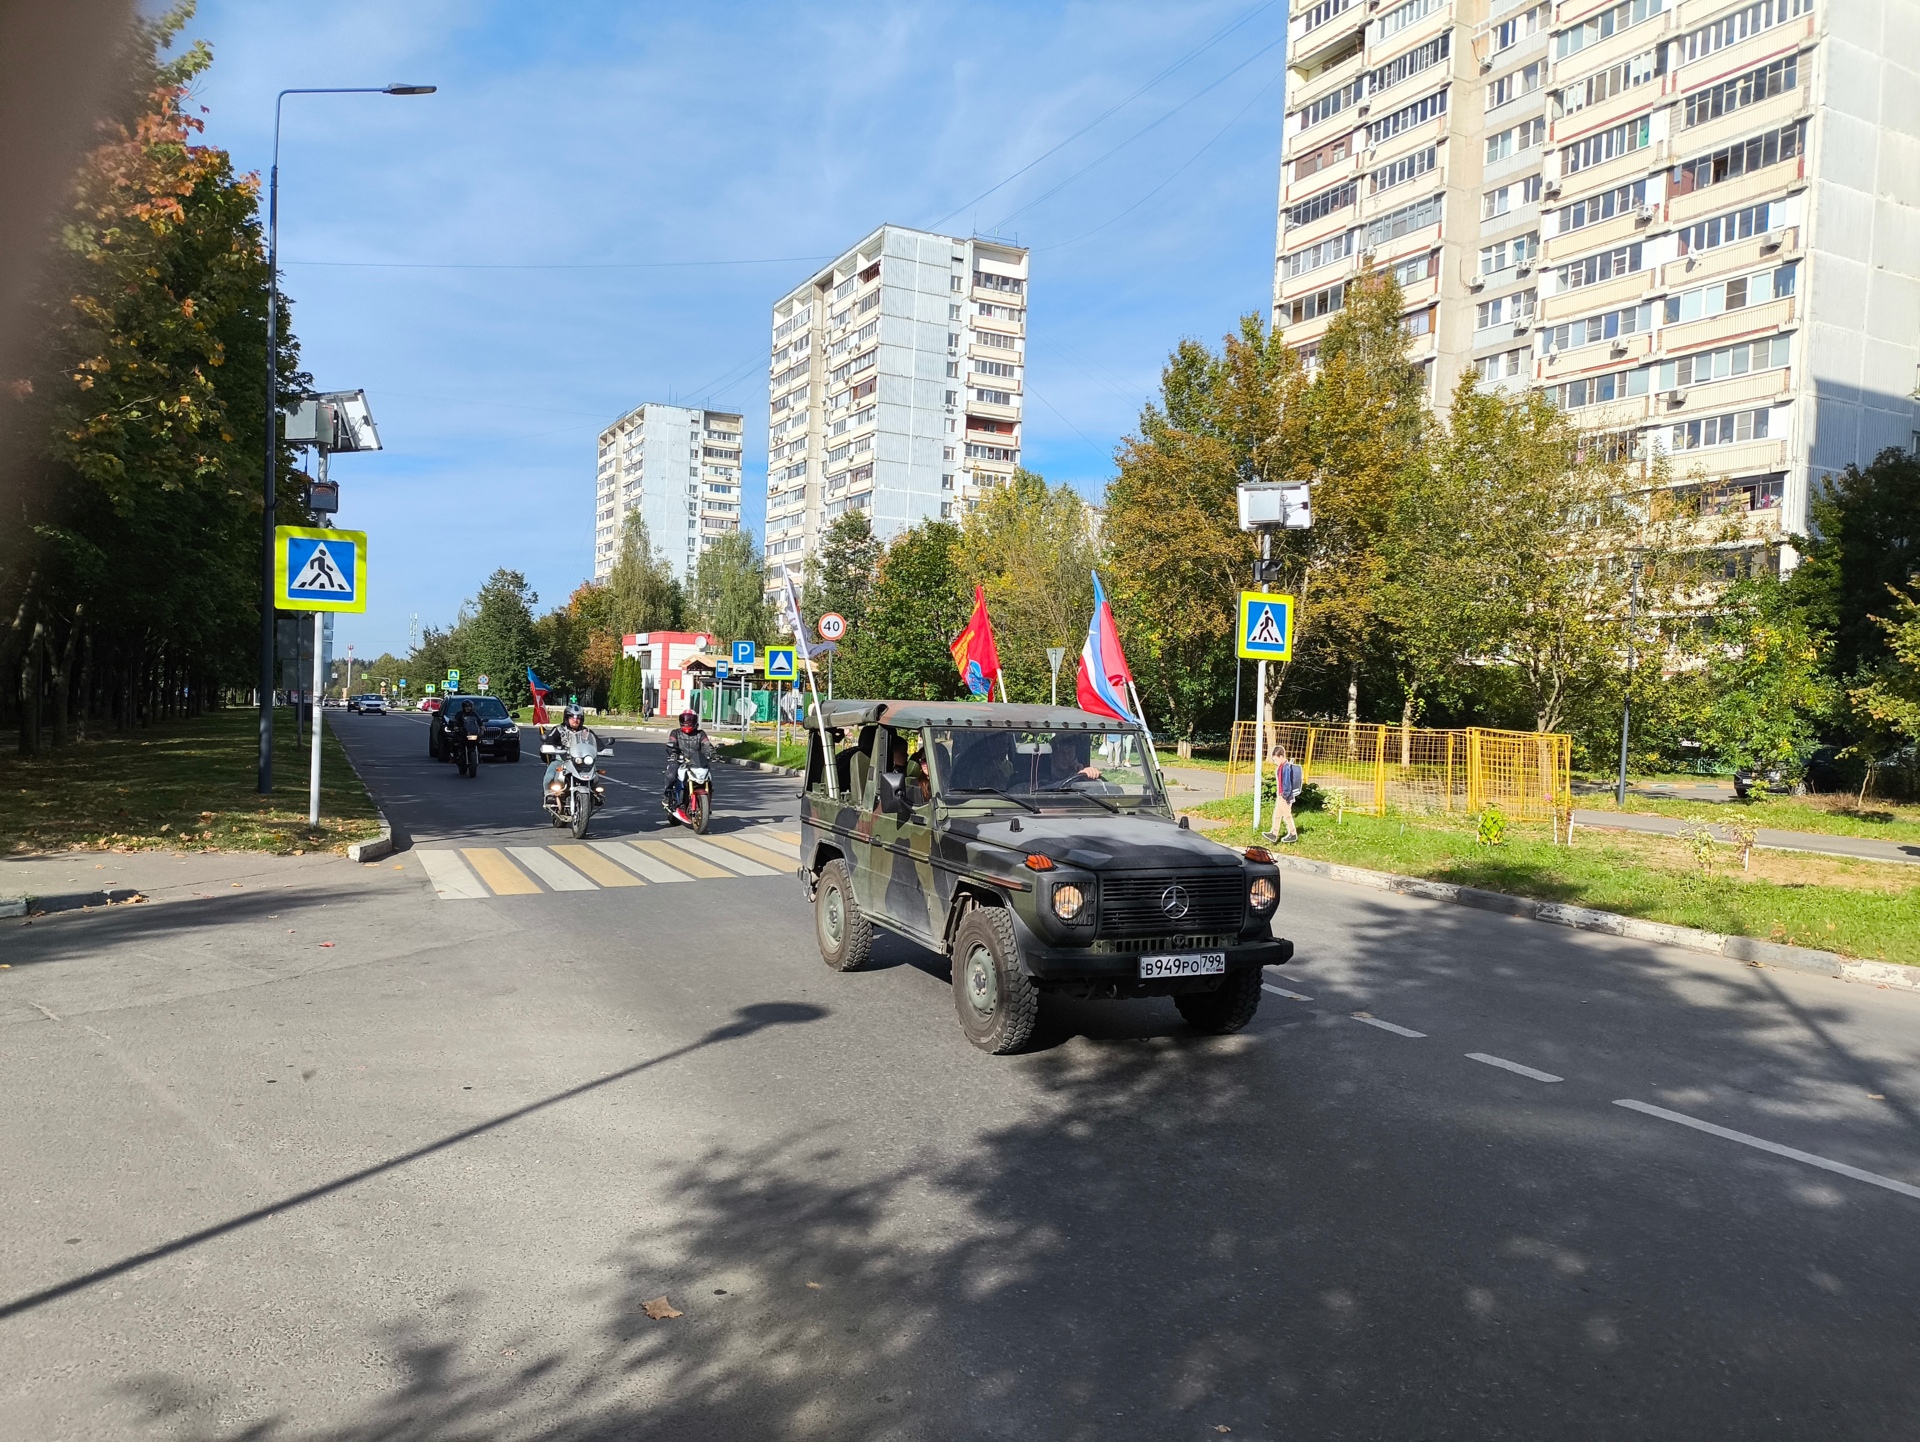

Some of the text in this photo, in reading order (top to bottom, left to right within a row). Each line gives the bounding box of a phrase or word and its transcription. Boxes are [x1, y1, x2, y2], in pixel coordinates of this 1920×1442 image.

[823, 620, 840, 631] 40
[738, 643, 750, 661] P
[1201, 955, 1221, 968] 799
